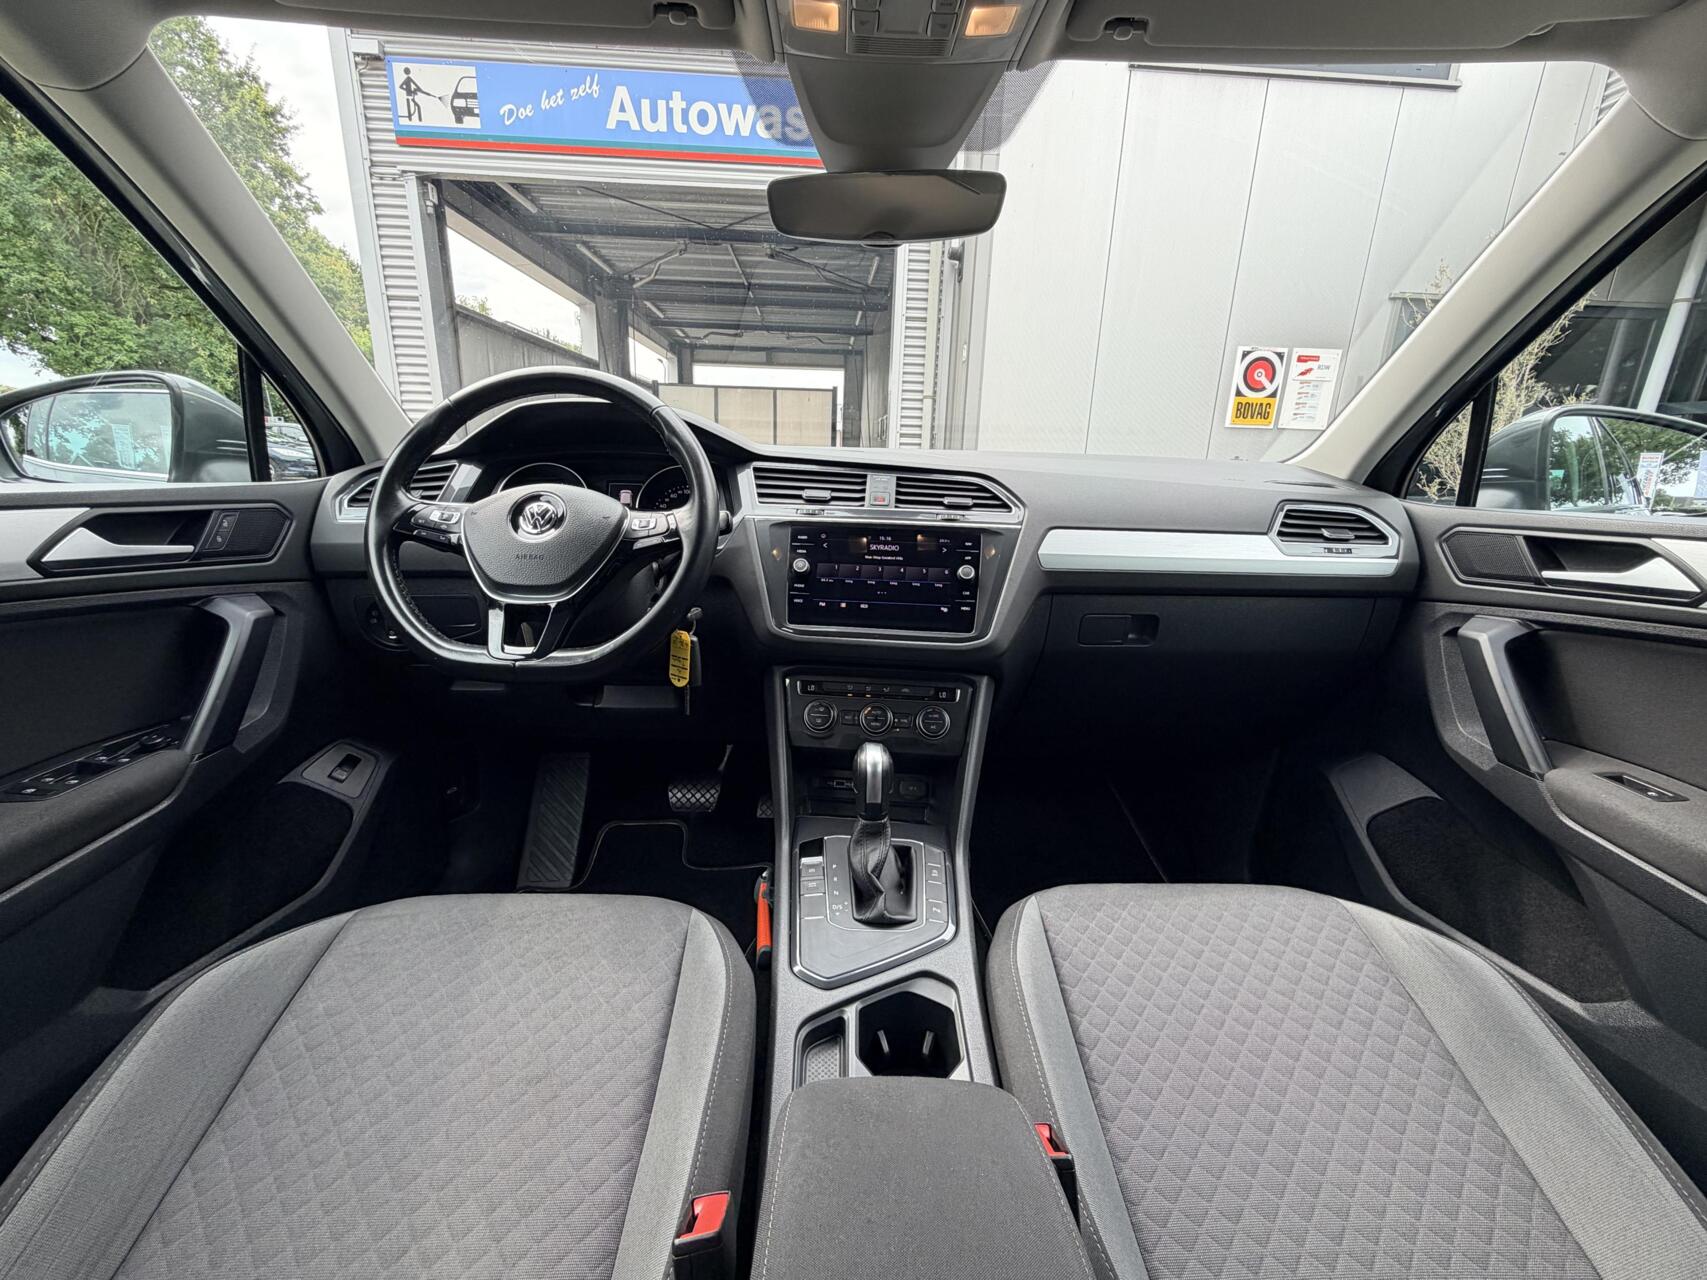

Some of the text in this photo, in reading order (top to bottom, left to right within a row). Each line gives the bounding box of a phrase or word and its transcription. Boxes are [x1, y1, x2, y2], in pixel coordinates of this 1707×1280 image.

[499, 73, 601, 126] Doe het zelf
[606, 85, 811, 142] Autowas
[1235, 401, 1272, 420] BOVAG
[869, 544, 900, 552] SKYRADIO
